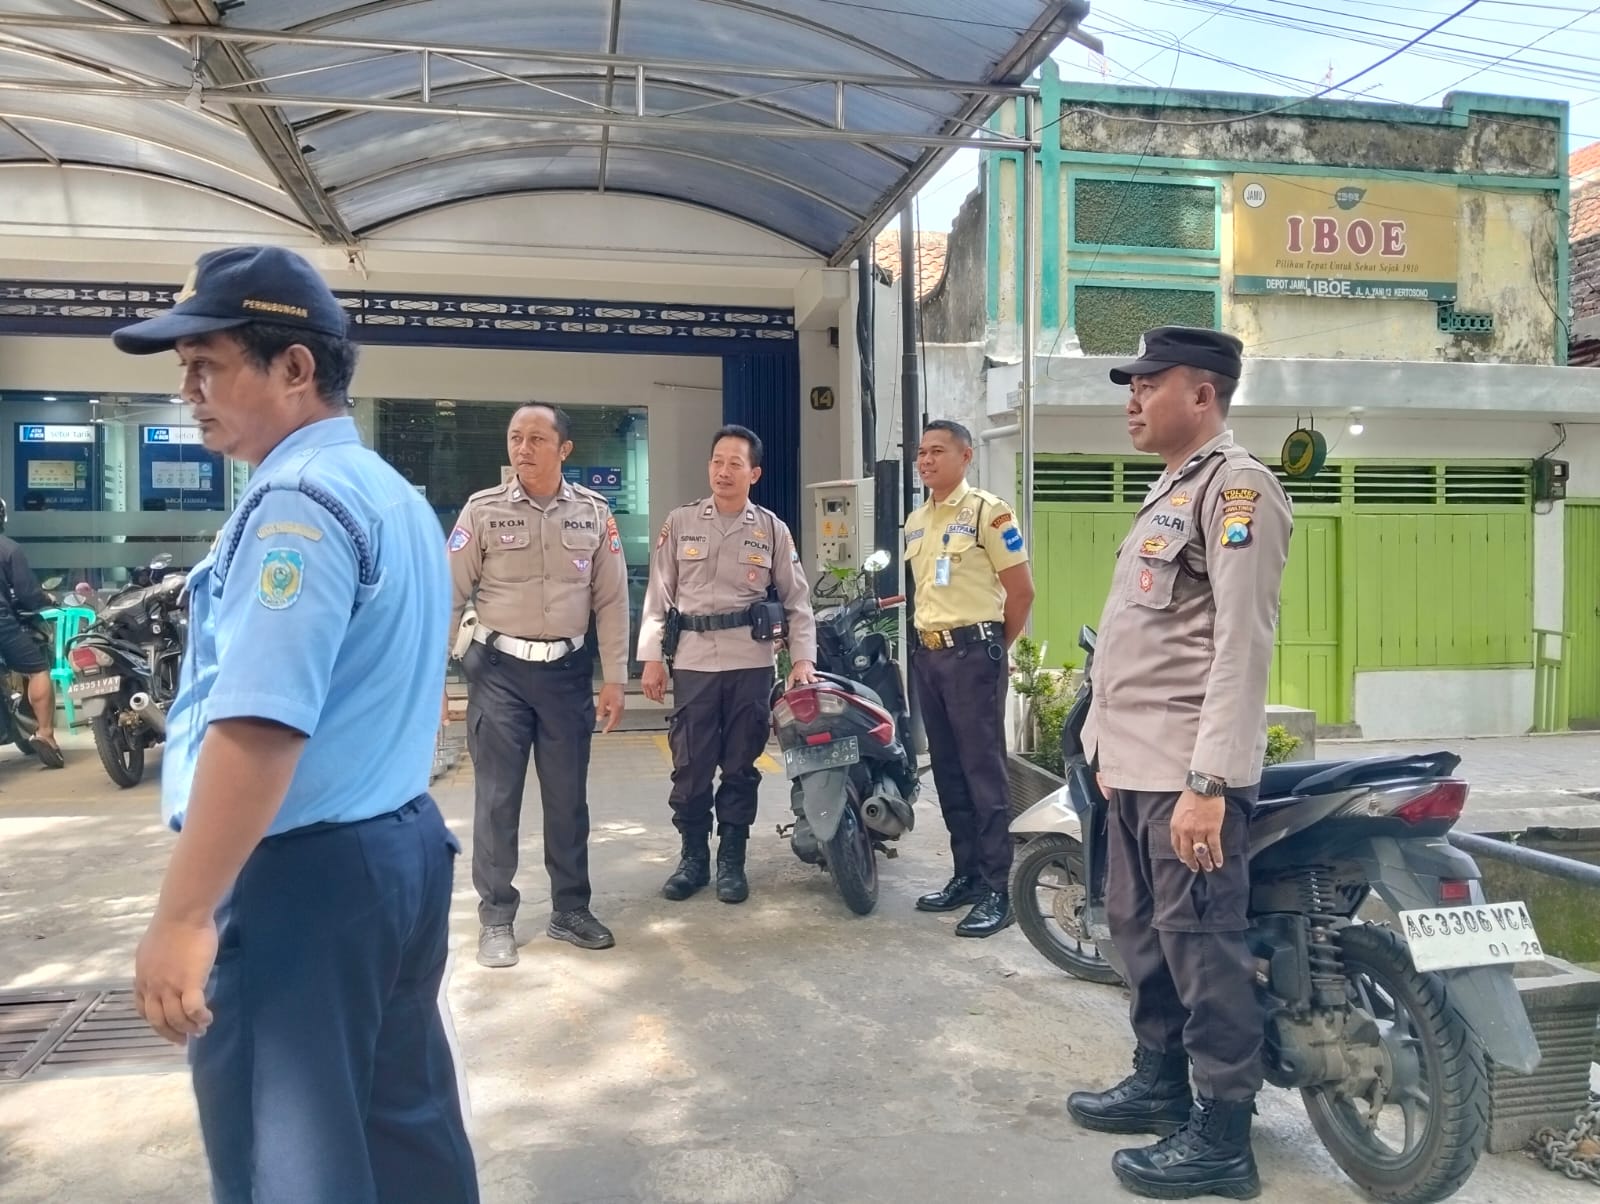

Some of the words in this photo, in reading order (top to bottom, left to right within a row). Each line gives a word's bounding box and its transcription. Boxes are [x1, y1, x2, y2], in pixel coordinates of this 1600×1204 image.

[1286, 215, 1408, 258] IBOE
[1275, 259, 1304, 269] Pilihan
[1306, 260, 1327, 272] Tepat
[1329, 260, 1351, 270] Untuk
[1379, 263, 1399, 275] Sejak
[1402, 263, 1419, 273] 1910
[1266, 278, 1288, 289] DEPOT
[1289, 279, 1308, 290] JAMU
[1313, 280, 1351, 295] IBOE
[1394, 288, 1429, 298] KERTOSONO
[811, 389, 832, 407] 14
[564, 520, 594, 530] POLRI
[1151, 514, 1185, 532] POLRI
[744, 539, 770, 552] POLRI
[1405, 913, 1436, 941] AG
[1434, 909, 1493, 936] 3306
[1488, 942, 1510, 957] 01
[1520, 940, 1542, 956] 28
